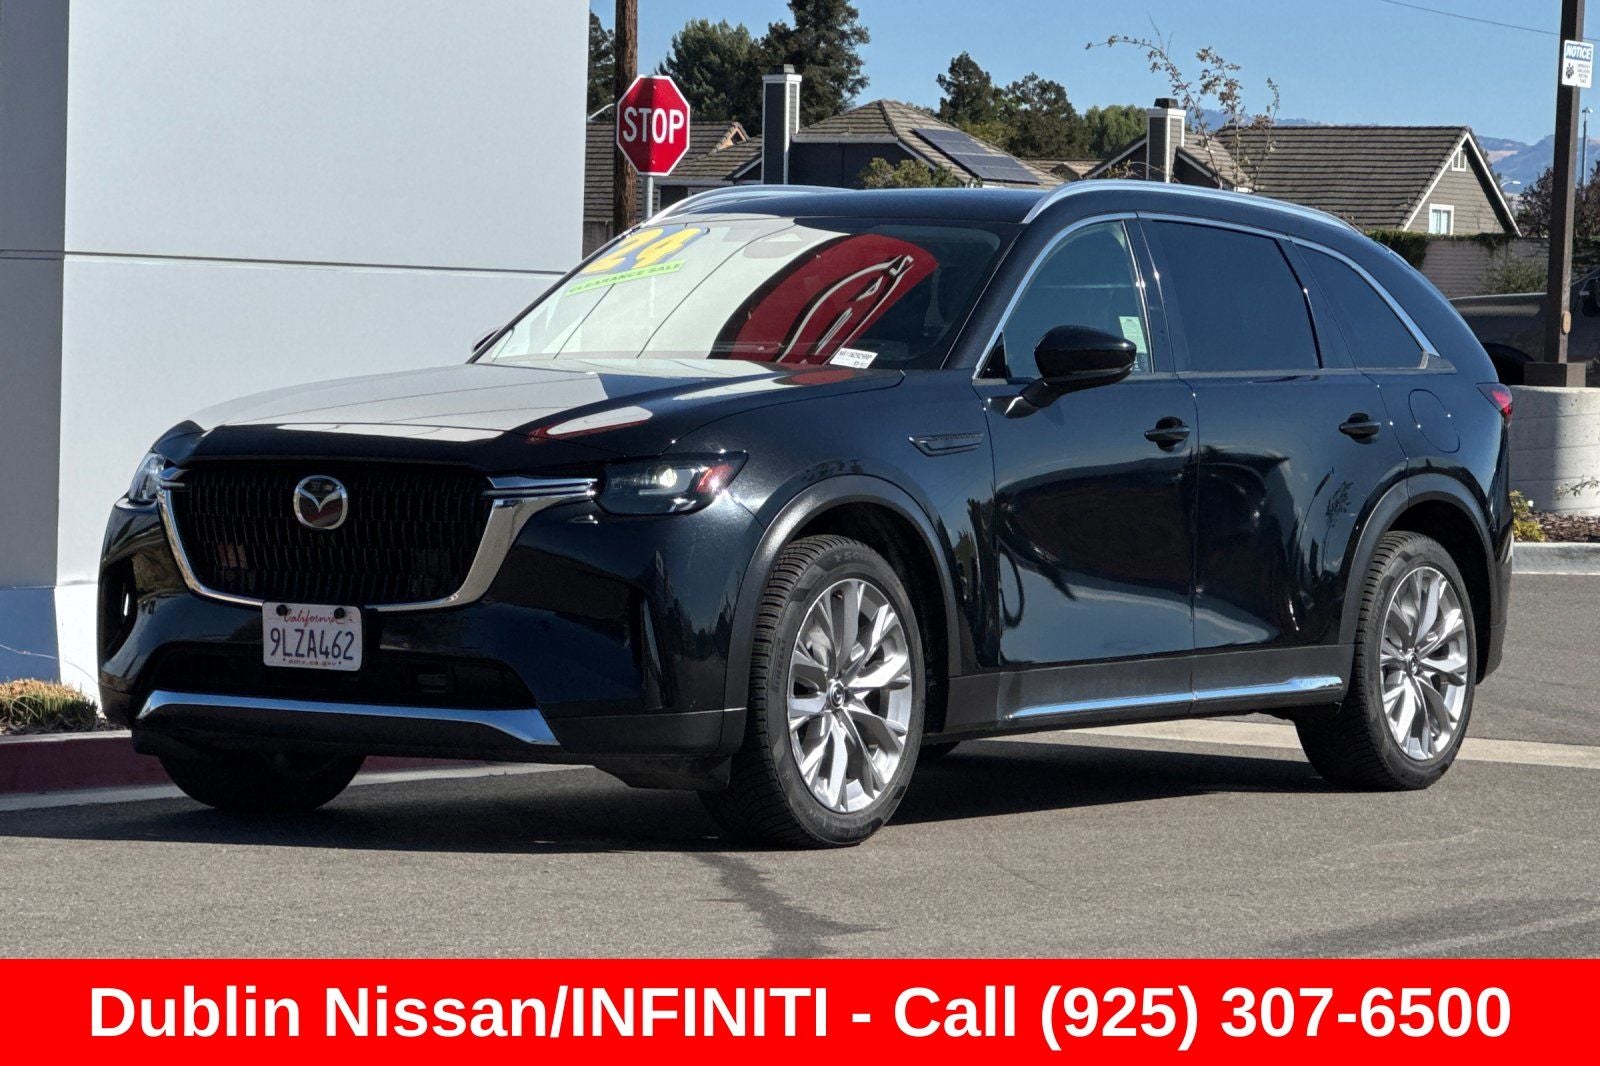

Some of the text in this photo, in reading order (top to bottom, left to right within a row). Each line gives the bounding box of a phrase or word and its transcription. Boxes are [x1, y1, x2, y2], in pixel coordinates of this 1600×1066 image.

[1566, 44, 1592, 60] NOTICE
[622, 106, 685, 144] STOP
[569, 262, 681, 293] CLEARANCE SALE
[284, 608, 345, 628] California
[270, 627, 355, 661] 9LZA462
